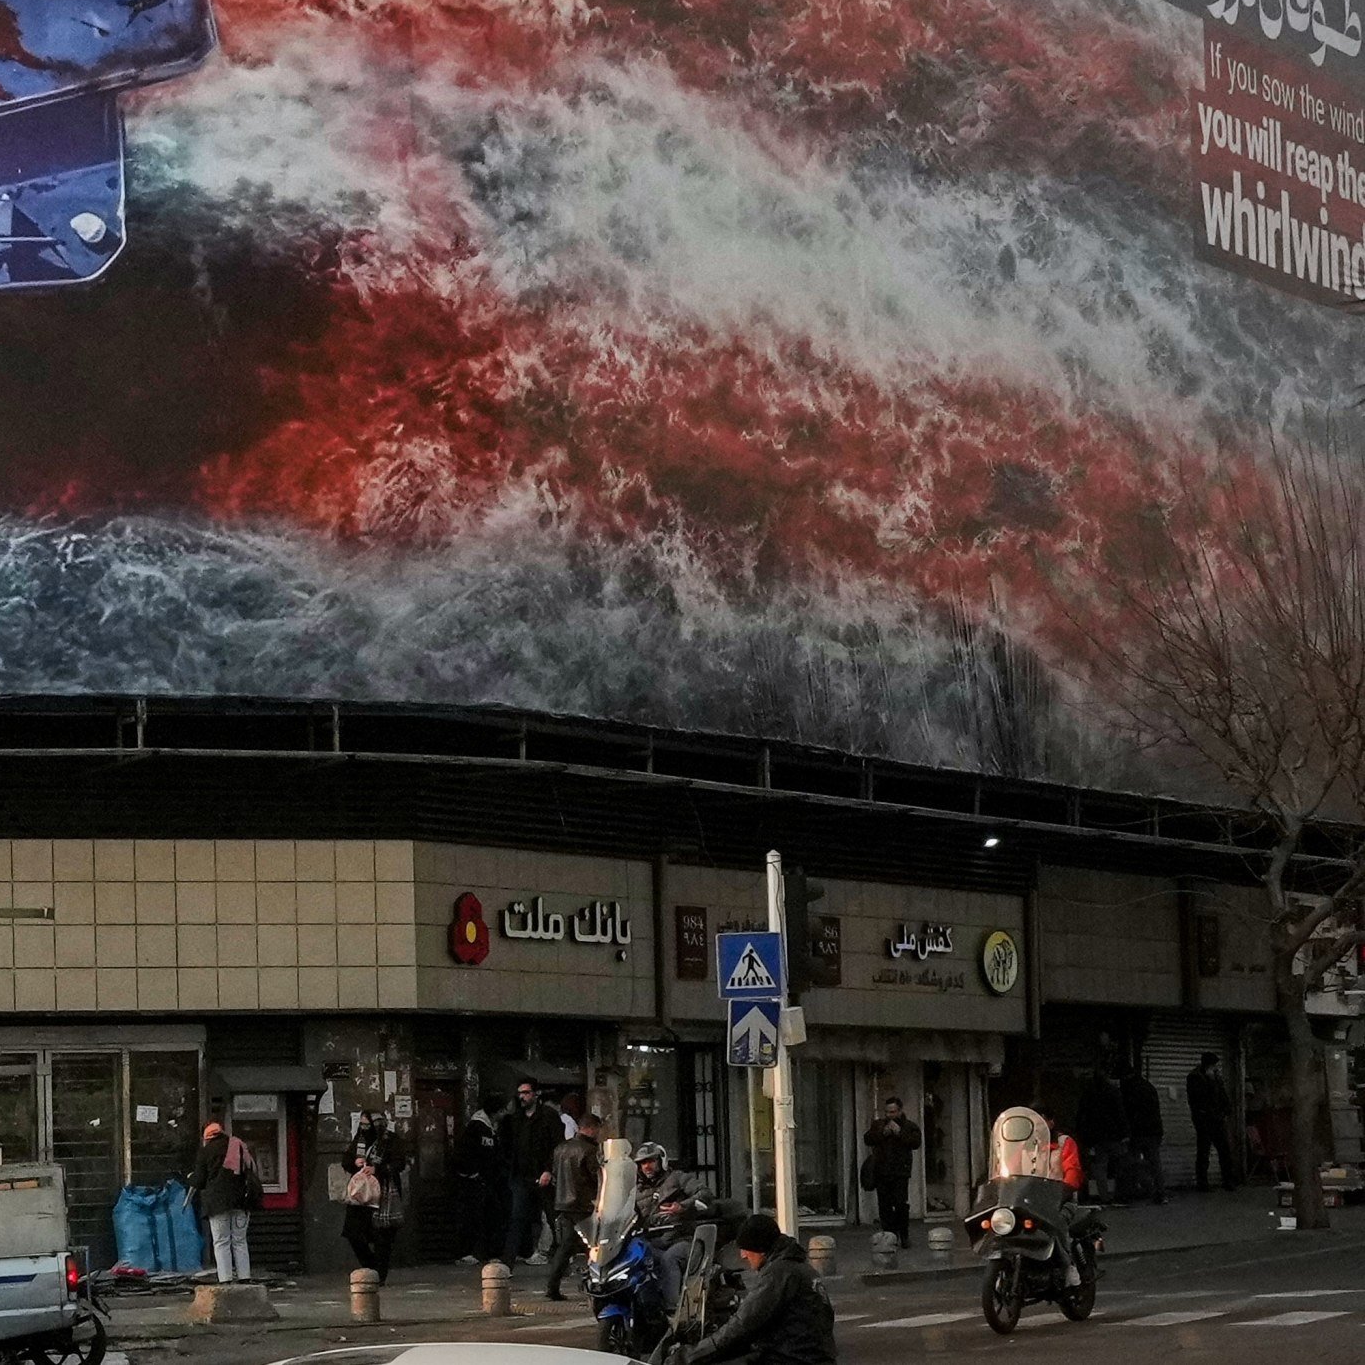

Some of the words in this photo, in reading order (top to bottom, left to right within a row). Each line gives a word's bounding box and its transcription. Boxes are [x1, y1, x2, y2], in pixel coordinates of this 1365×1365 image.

[1210, 40, 1222, 80] If
[1227, 57, 1258, 95] you
[1262, 74, 1295, 113] sow
[1300, 83, 1325, 125] the
[1329, 101, 1365, 145] wind
[1198, 102, 1242, 155] you
[1245, 115, 1283, 173] will
[1285, 139, 1334, 204] reap
[1336, 149, 1365, 209] the
[504, 896, 566, 940] ملت
[824, 926, 838, 939] 86
[890, 923, 916, 958] ملی
[917, 924, 953, 960] کفش
